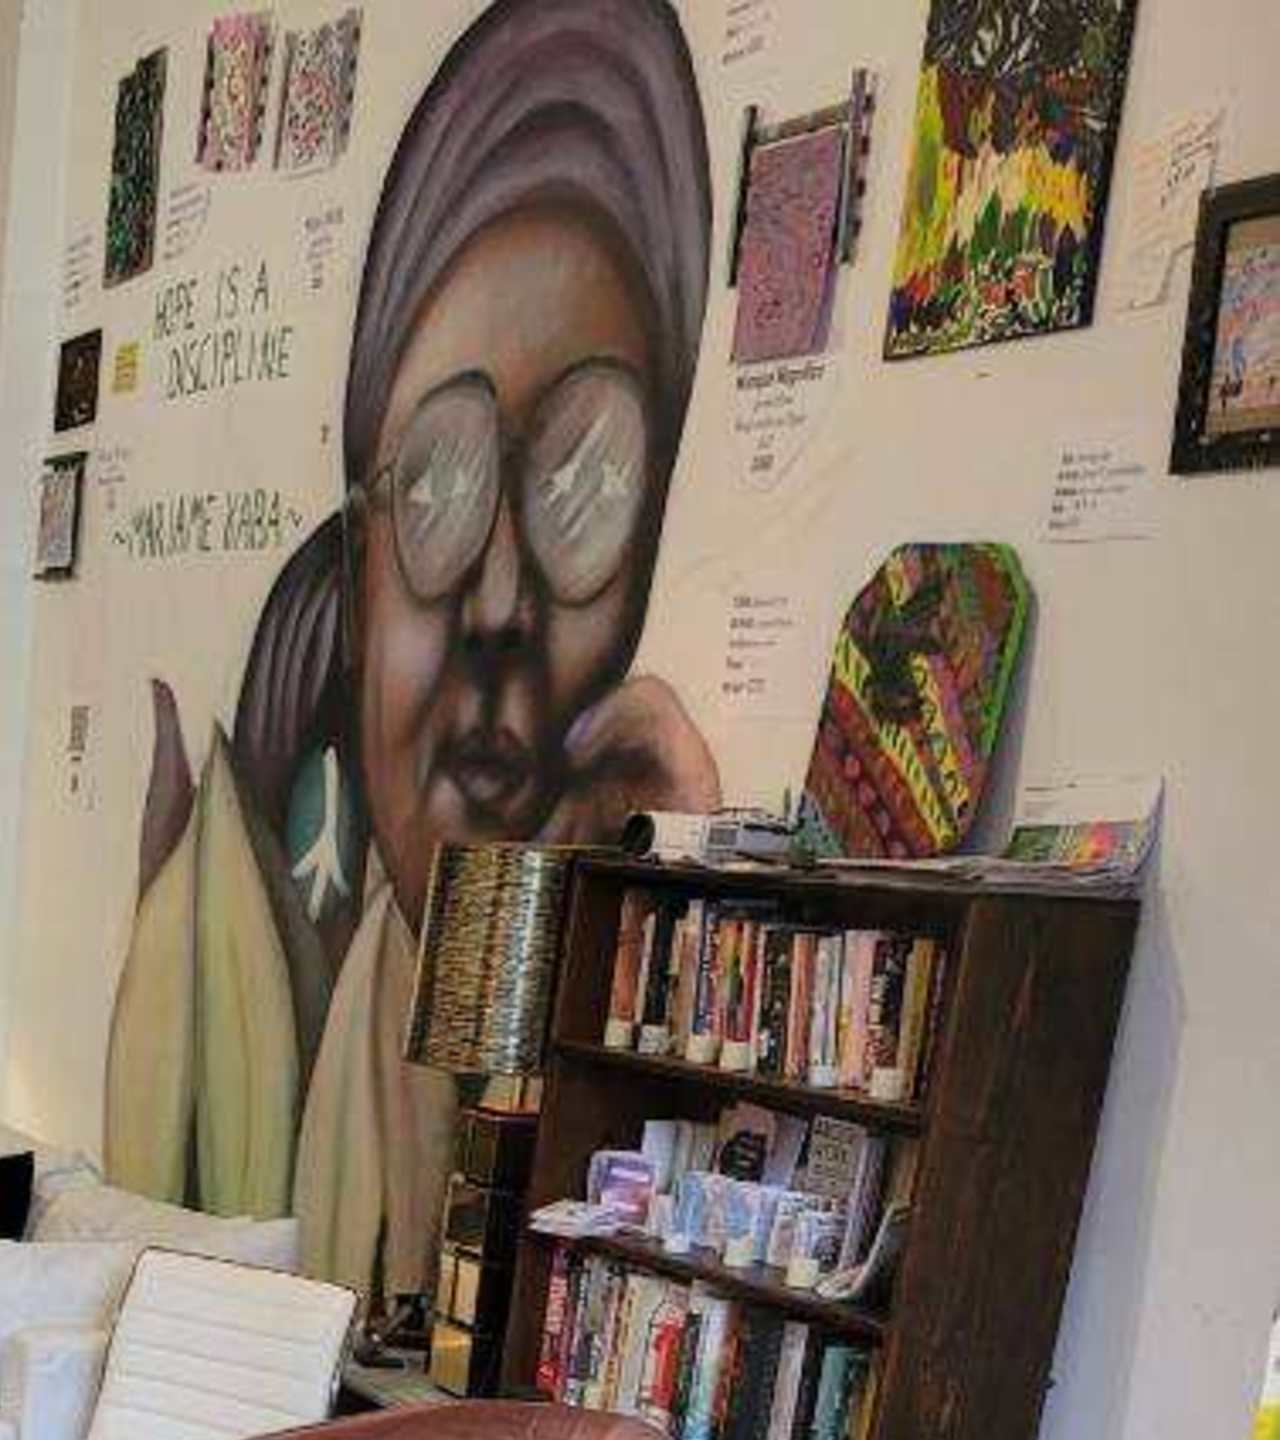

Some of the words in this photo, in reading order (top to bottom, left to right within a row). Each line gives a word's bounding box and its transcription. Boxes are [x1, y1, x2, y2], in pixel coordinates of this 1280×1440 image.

[154, 278, 197, 340] HOPE
[216, 264, 241, 321] IS
[251, 259, 270, 316] A
[165, 325, 294, 400] DISCIPLINE
